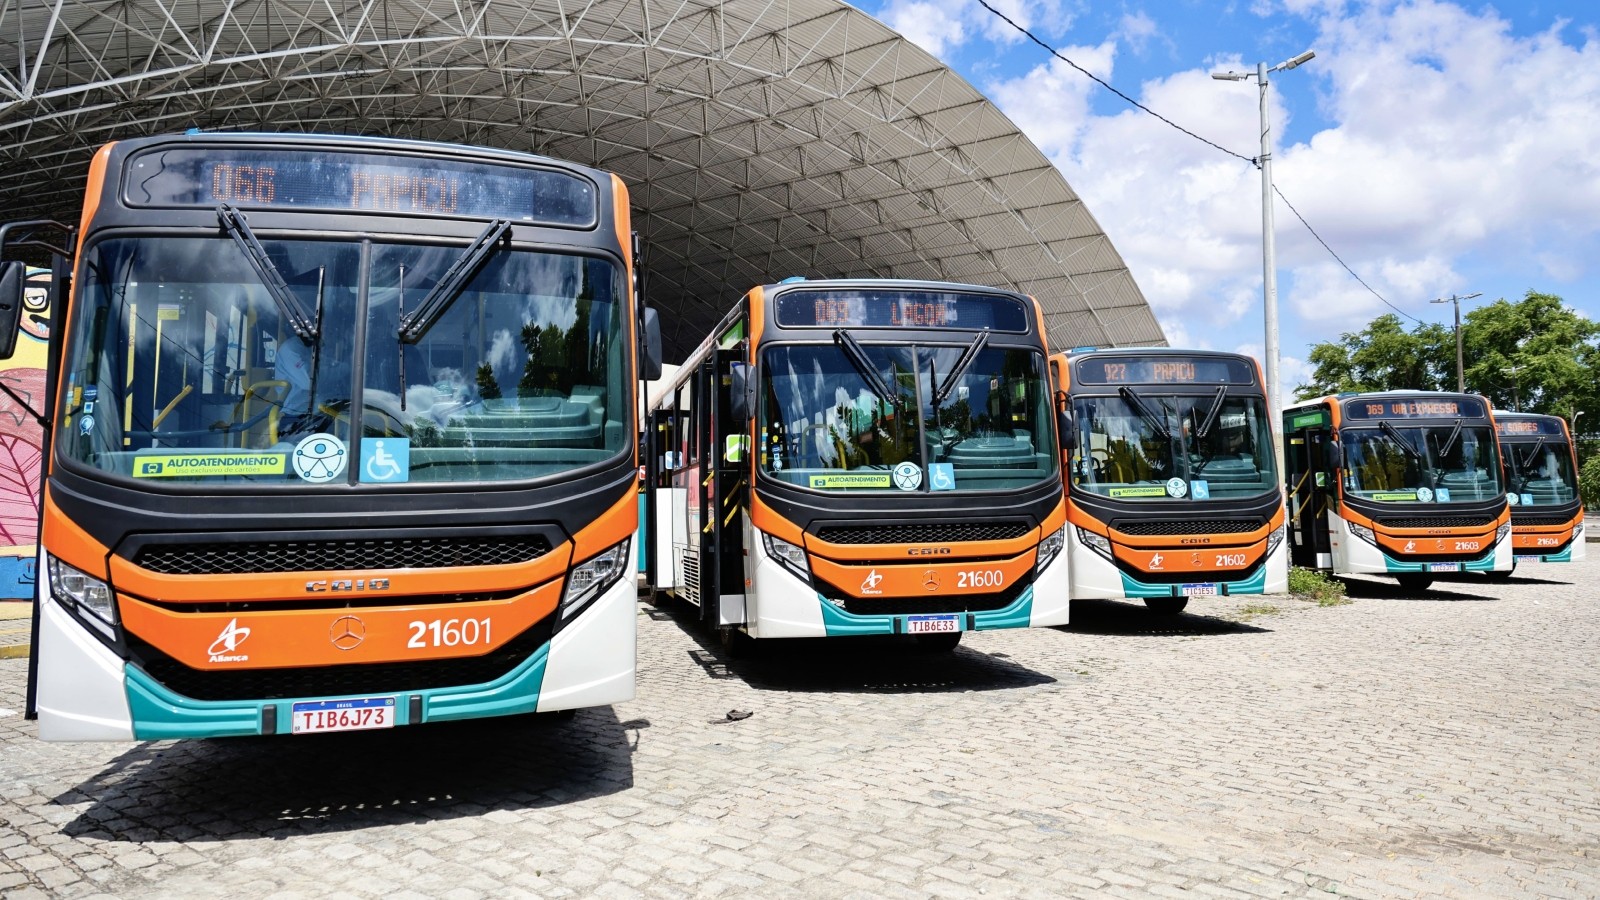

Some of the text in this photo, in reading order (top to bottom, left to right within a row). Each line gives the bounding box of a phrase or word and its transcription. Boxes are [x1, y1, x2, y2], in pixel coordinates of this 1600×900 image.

[212, 164, 458, 213] 066 PAPICU
[815, 299, 946, 326] 069 LAGOA
[1153, 363, 1195, 380] PAPICU
[1391, 403, 1408, 415] VIA
[1409, 402, 1458, 415] EXPRESSA
[1507, 422, 1538, 432] SOARES
[167, 457, 278, 468] AUTOATENDIMENTO
[1455, 542, 1479, 550] 21603
[1537, 538, 1559, 546] 21604
[907, 547, 951, 555] CAIO
[1216, 554, 1246, 567] 21602
[305, 578, 390, 592] CAIO
[957, 570, 1003, 588] 21600
[407, 617, 491, 648] 21601
[913, 621, 954, 632] TIB6E33
[208, 654, 249, 663] Aliança
[303, 708, 385, 729] TIB6J73
